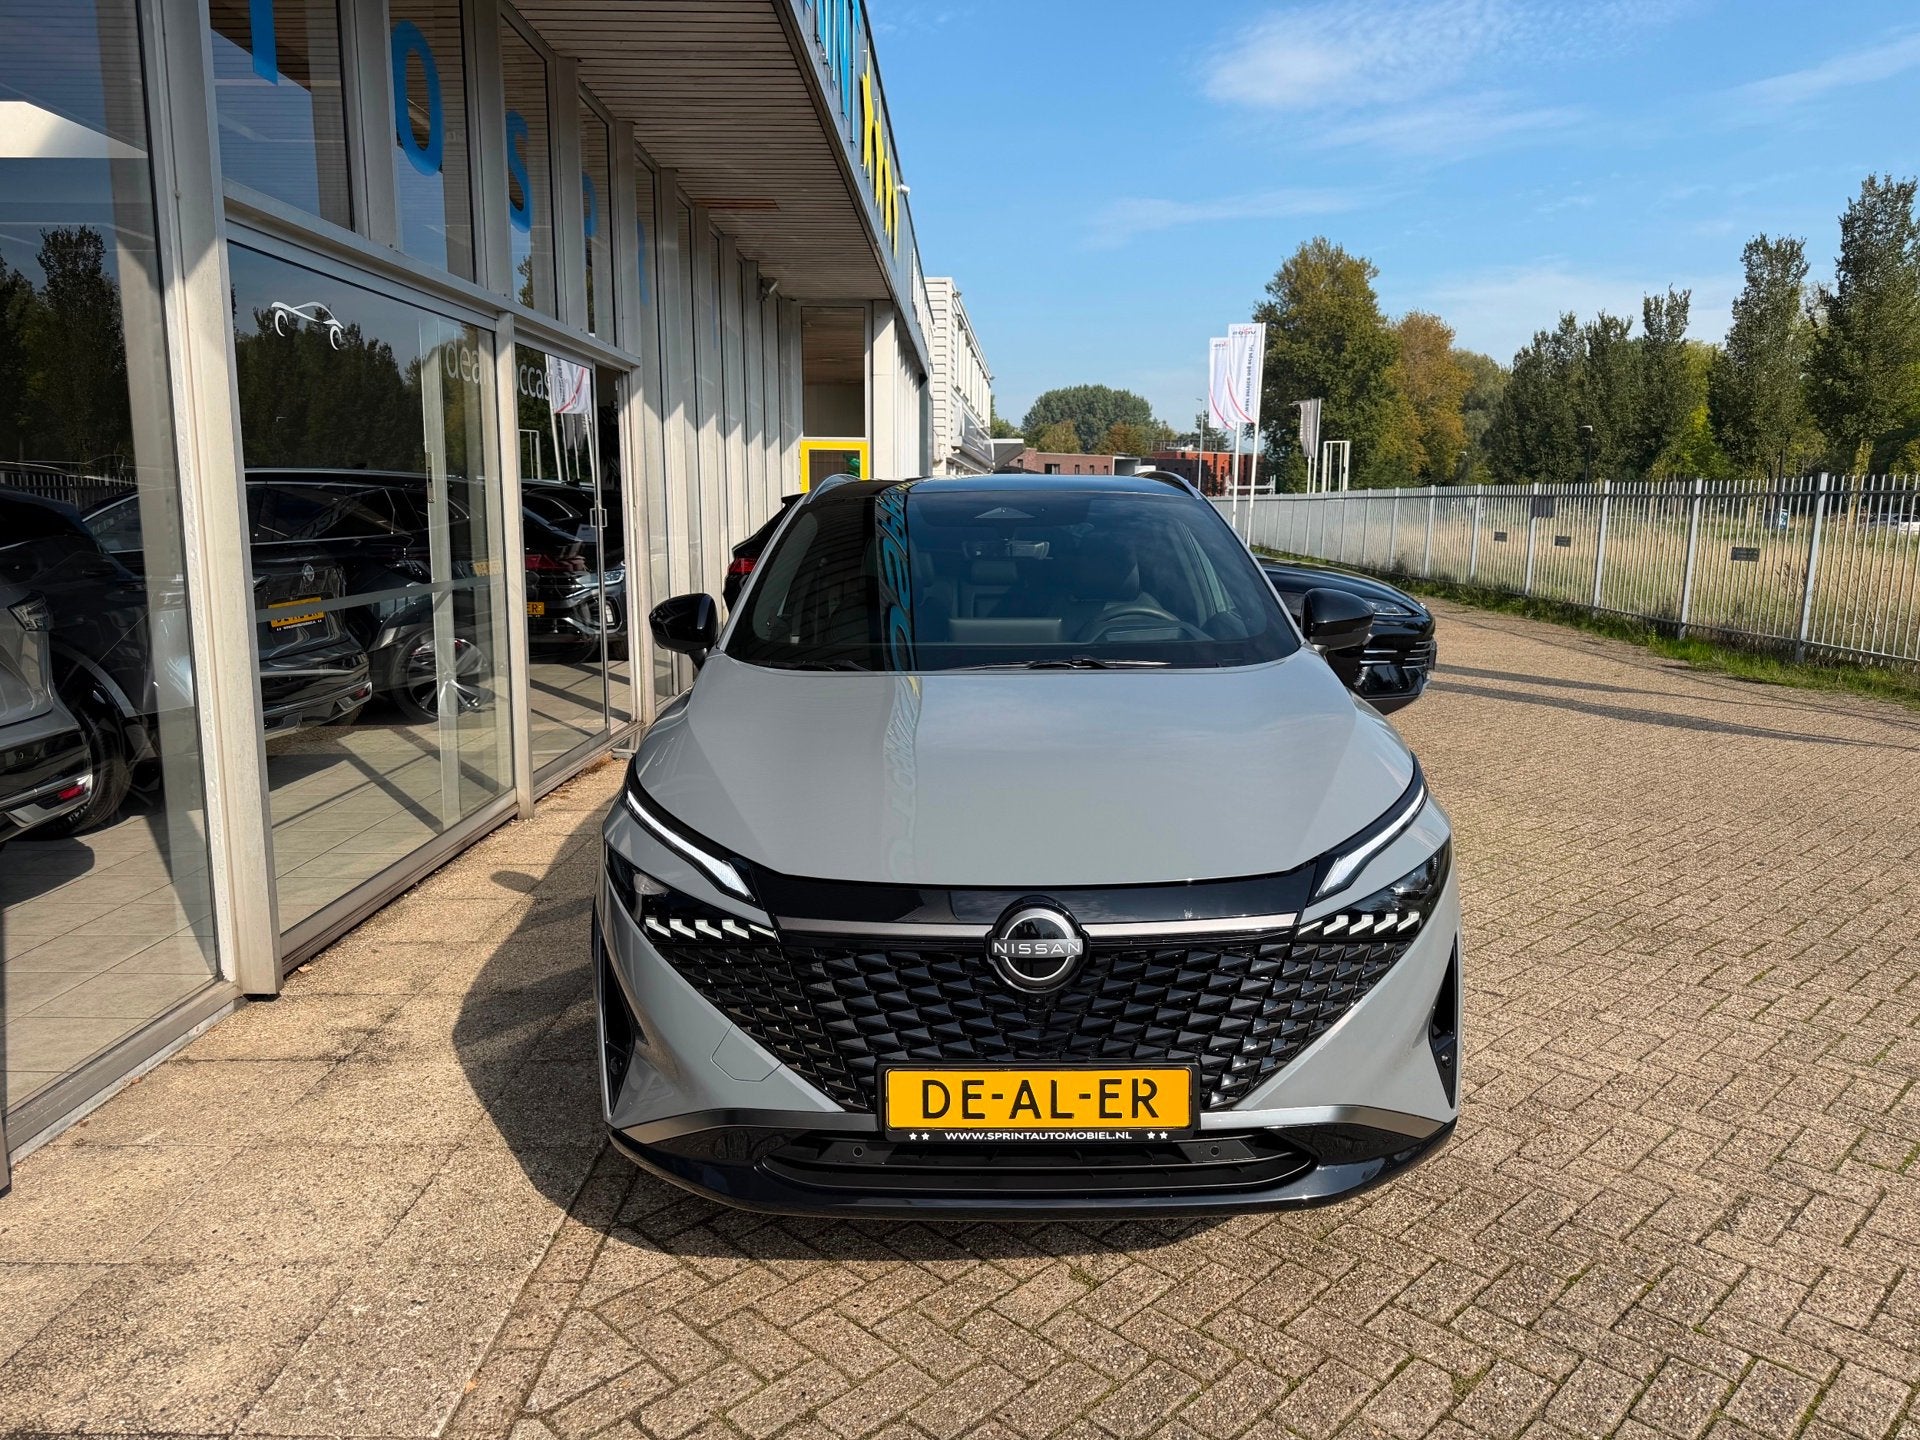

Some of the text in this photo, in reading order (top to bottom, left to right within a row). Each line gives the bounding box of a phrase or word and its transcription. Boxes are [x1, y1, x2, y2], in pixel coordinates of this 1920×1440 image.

[993, 942, 1081, 955] NISSAN
[922, 1078, 1159, 1119] DE-AL-ER
[944, 1131, 1133, 1141] WWW.SPRINTAUTOMOBIEL.NL
